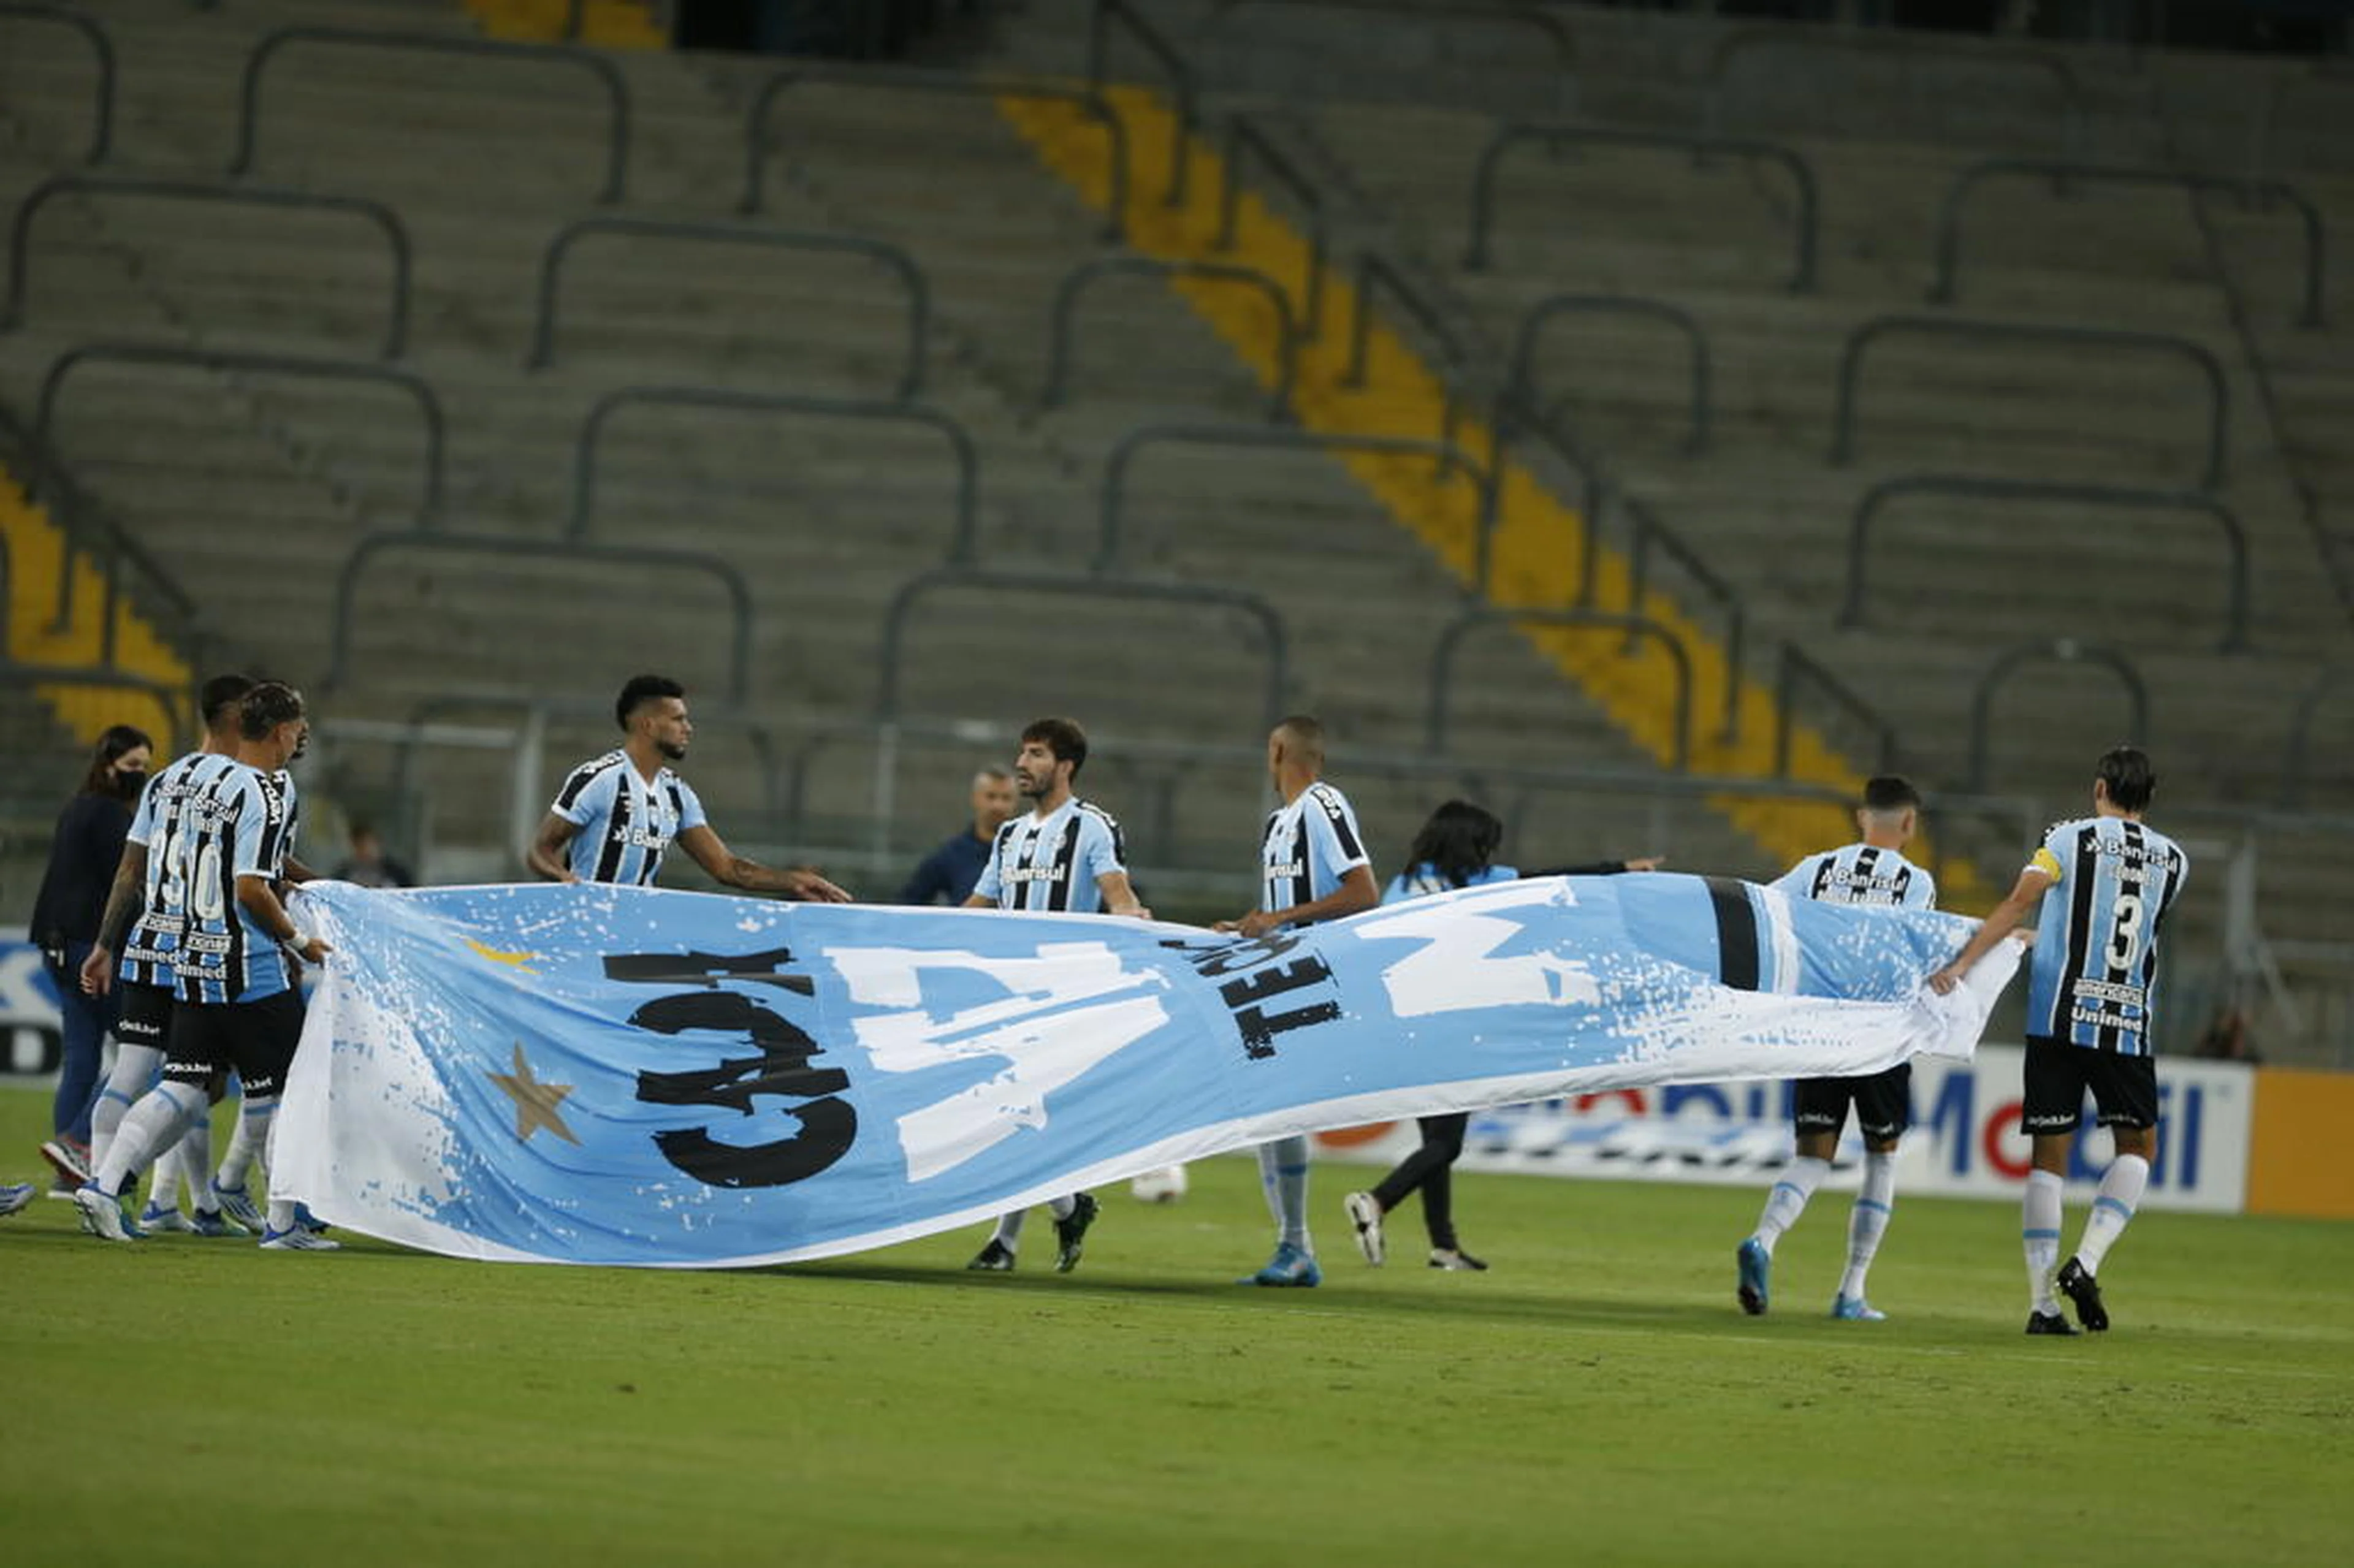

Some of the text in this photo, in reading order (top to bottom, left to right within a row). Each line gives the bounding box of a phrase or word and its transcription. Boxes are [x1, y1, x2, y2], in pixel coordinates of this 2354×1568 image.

[2106, 840, 2178, 873] Banrisul
[1837, 869, 1905, 892] Banrisul
[2105, 894, 2143, 969] 3
[2071, 1006, 2143, 1032] Unimed
